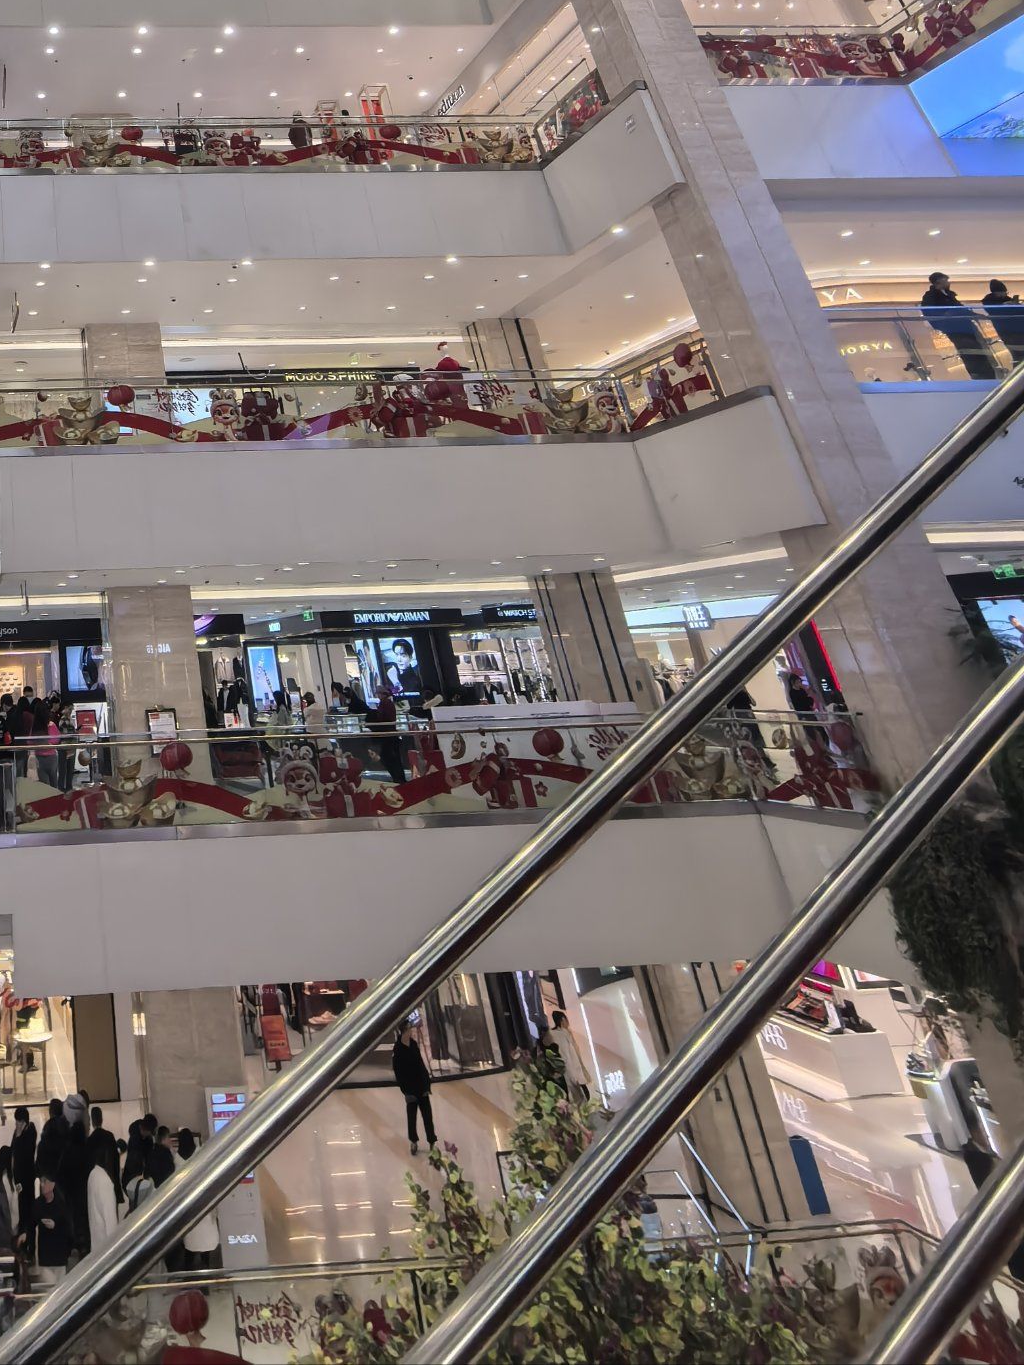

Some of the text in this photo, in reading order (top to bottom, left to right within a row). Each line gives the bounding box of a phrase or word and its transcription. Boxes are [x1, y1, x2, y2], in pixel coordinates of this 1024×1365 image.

[821, 287, 863, 303] YA
[354, 611, 430, 624] EMPORIO ARMANI
